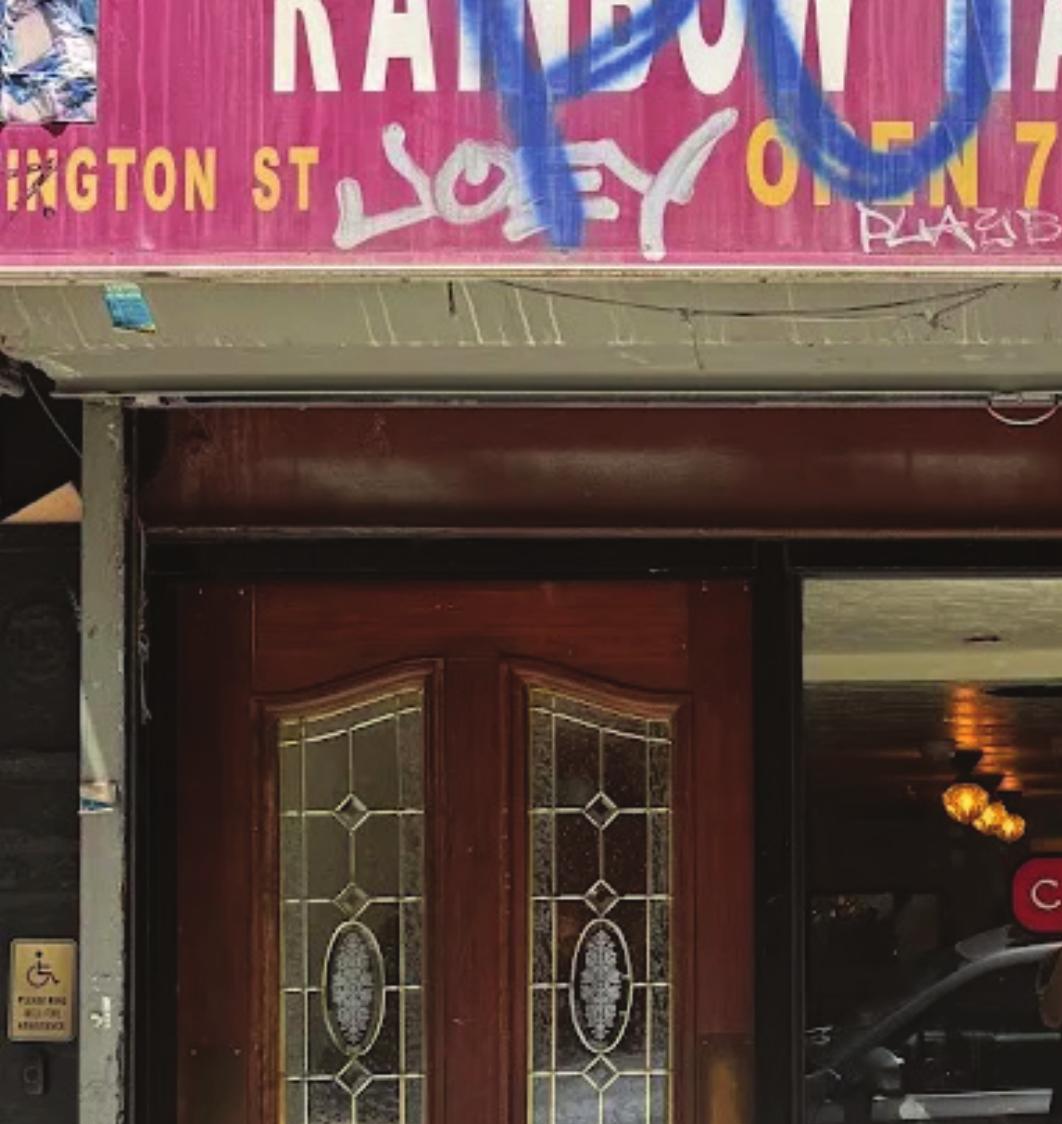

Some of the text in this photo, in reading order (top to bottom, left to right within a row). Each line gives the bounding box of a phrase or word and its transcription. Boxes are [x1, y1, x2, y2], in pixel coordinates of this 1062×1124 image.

[252, 147, 319, 212] ST
[745, 119, 979, 208] OEN
[1016, 122, 1058, 208] 7
